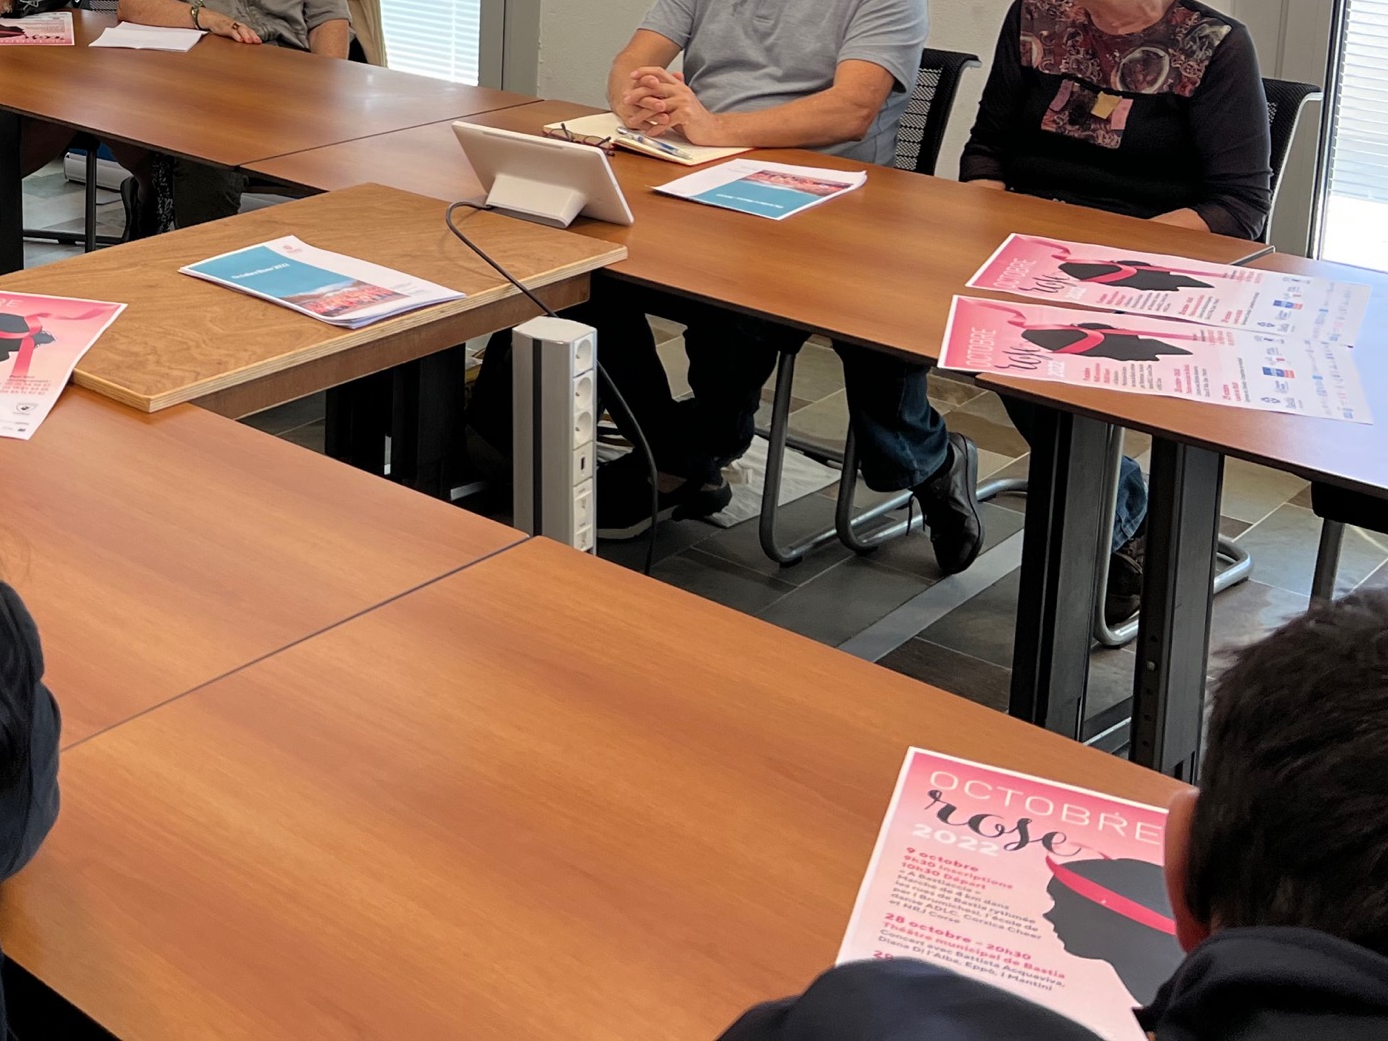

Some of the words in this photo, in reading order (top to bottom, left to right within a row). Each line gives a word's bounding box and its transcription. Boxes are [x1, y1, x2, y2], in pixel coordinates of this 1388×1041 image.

[966, 327, 997, 367] OCTOBRE
[924, 789, 1082, 857] rose
[929, 770, 1163, 845] OCTOBRE
[912, 823, 1003, 858] 2022
[902, 862, 940, 877] 10h30
[944, 873, 986, 890] Départ
[904, 855, 936, 868] 9h30
[919, 852, 979, 872] octobre
[893, 887, 910, 896] par
[1024, 924, 1039, 932] de
[895, 881, 910, 889] les
[912, 886, 935, 896] rues
[954, 898, 987, 910] Bastia
[989, 907, 1036, 924] rythmée
[898, 875, 937, 890] Marche
[964, 893, 982, 902] km
[983, 899, 1010, 910] dans
[884, 912, 905, 924] 28
[909, 921, 972, 943] octobre
[986, 943, 1031, 960] 20h30
[891, 893, 923, 906] danse
[963, 914, 1005, 930] Corsica
[1007, 926, 1042, 940] Cheer
[929, 911, 961, 924] Corse
[878, 936, 909, 949] Diana
[1008, 974, 1052, 990] Mantini
[880, 929, 925, 946] Concert
[927, 944, 953, 954] avec
[955, 951, 1000, 968] Battista
[883, 921, 932, 941] Théâtre
[935, 938, 1001, 960] municipal
[1024, 963, 1065, 979] Bastia
